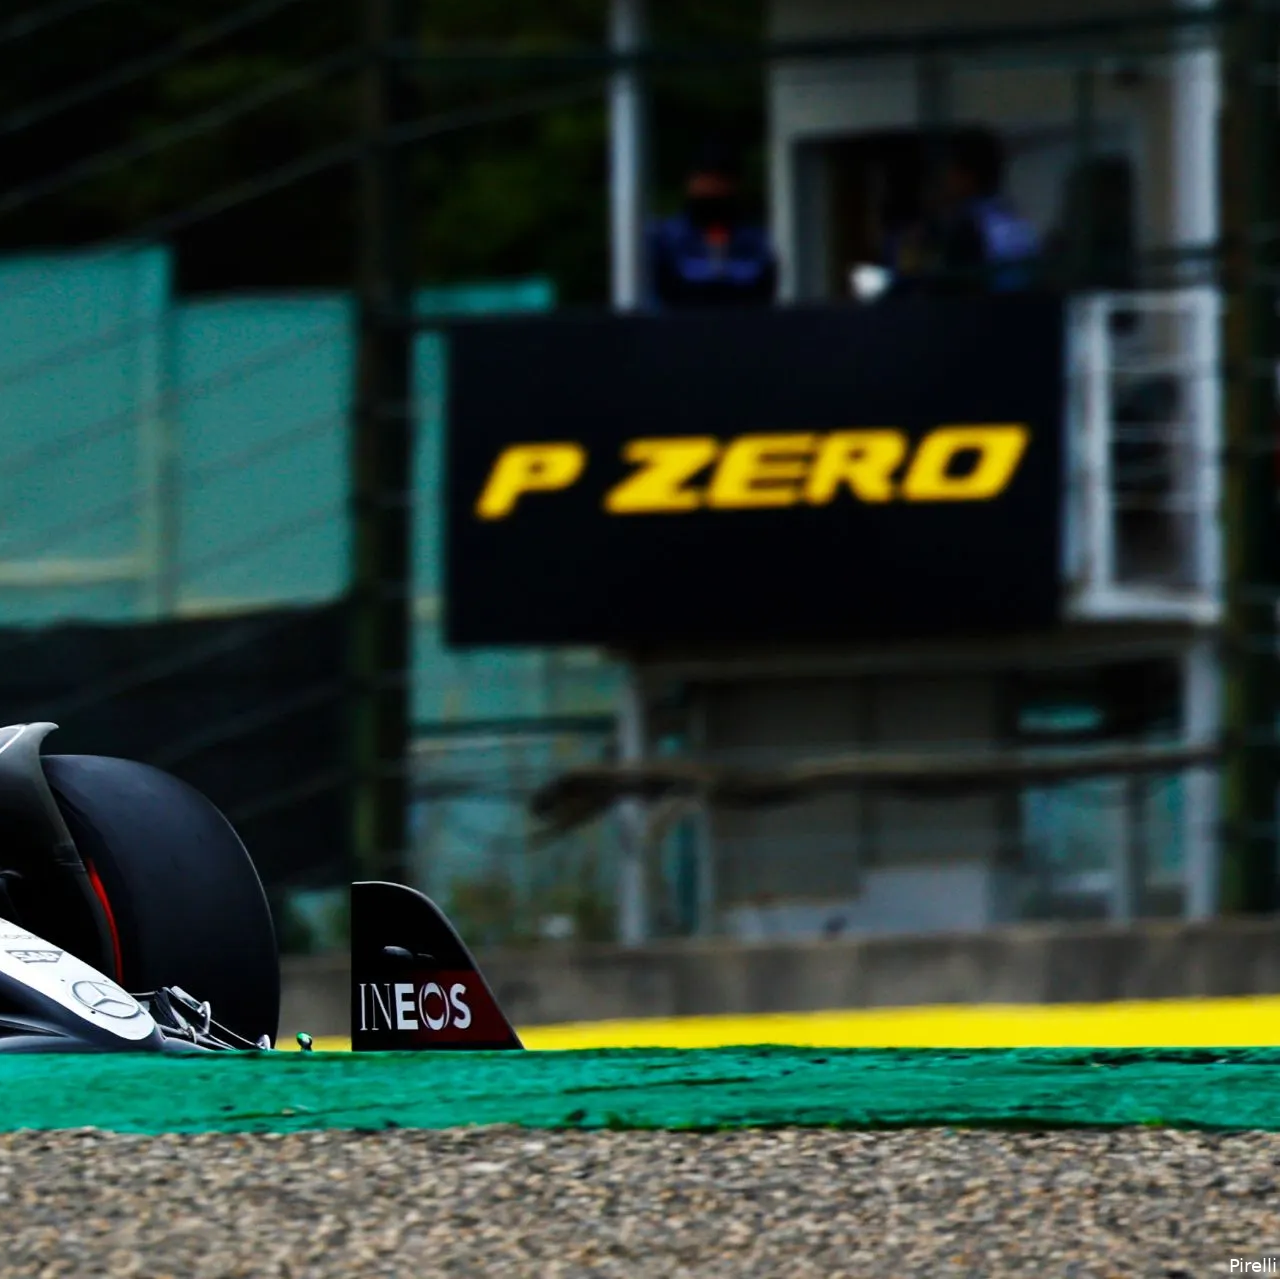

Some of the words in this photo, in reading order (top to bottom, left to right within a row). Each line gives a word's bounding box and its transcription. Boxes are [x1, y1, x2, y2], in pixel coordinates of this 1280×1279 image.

[476, 440, 588, 520] P
[604, 422, 1033, 516] ZERO
[358, 982, 472, 1031] INEOS
